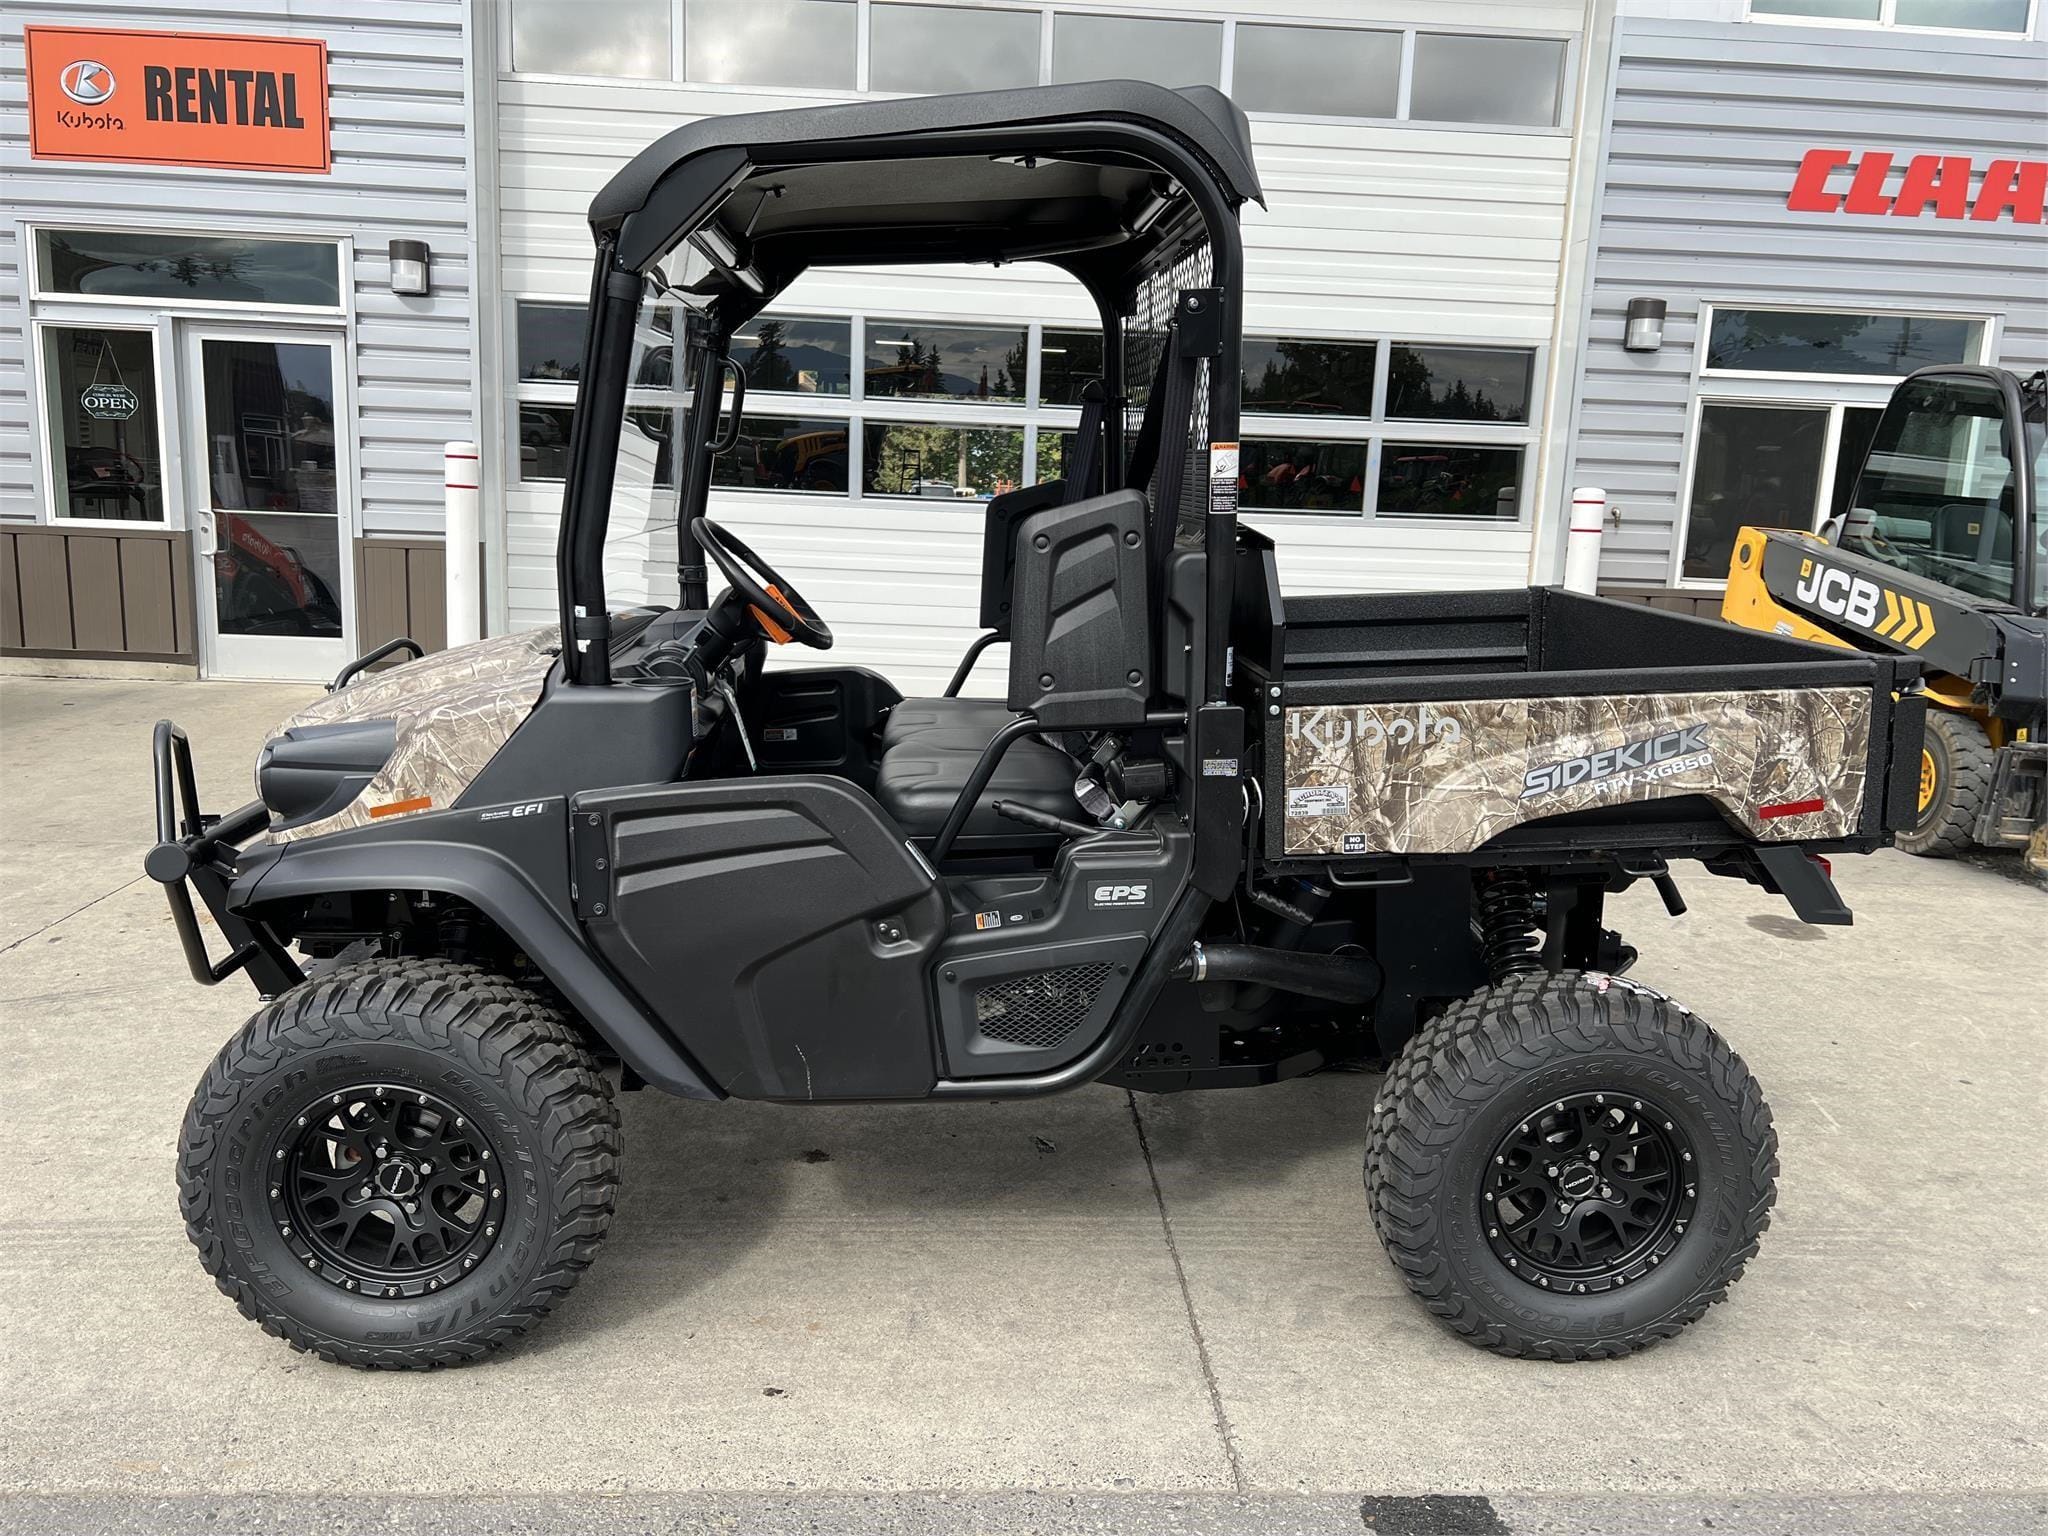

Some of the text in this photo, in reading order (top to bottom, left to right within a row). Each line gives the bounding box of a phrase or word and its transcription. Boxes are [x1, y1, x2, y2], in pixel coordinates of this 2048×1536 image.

[144, 65, 304, 129] RENTAL
[57, 110, 125, 131] Kubota
[1786, 149, 2048, 224] CLAA
[84, 396, 135, 409] OPEN
[1796, 562, 1880, 628] JCB
[1292, 704, 1461, 749] Kubota
[1519, 723, 1709, 800] SIDEKICK
[1595, 753, 1714, 795] RTV-XG850
[511, 803, 544, 817] EFI
[1094, 885, 1147, 901] EPS
